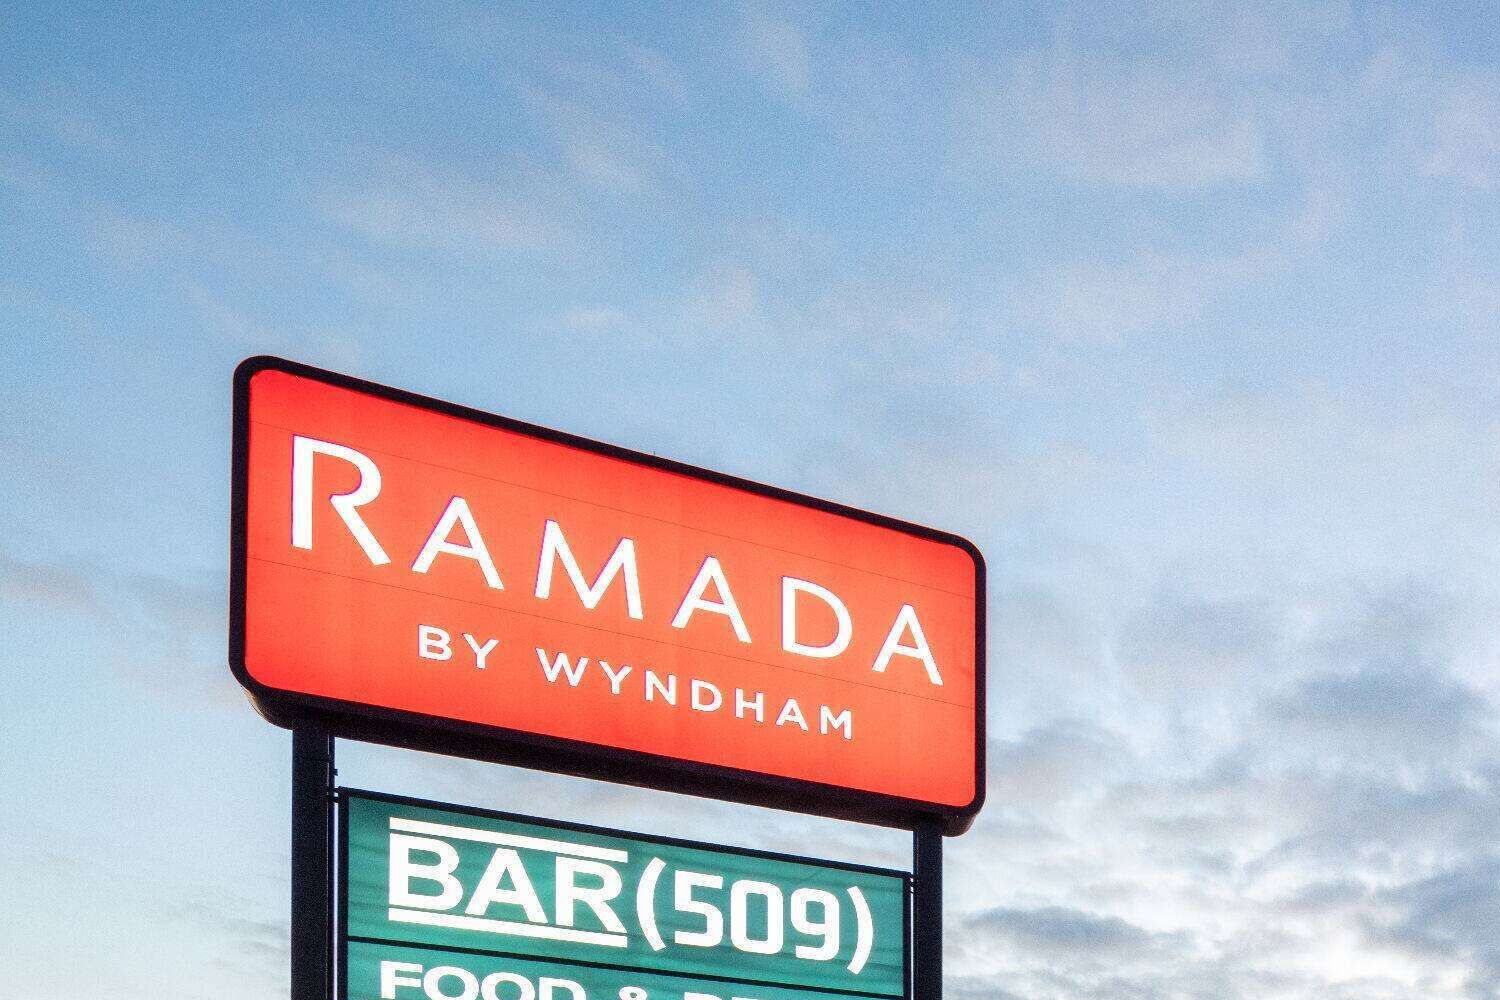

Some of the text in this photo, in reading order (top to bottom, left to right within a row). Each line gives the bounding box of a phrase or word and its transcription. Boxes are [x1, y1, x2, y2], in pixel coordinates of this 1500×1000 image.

[293, 436, 943, 685] RAMADA
[418, 625, 852, 740] BY WYNDHAM
